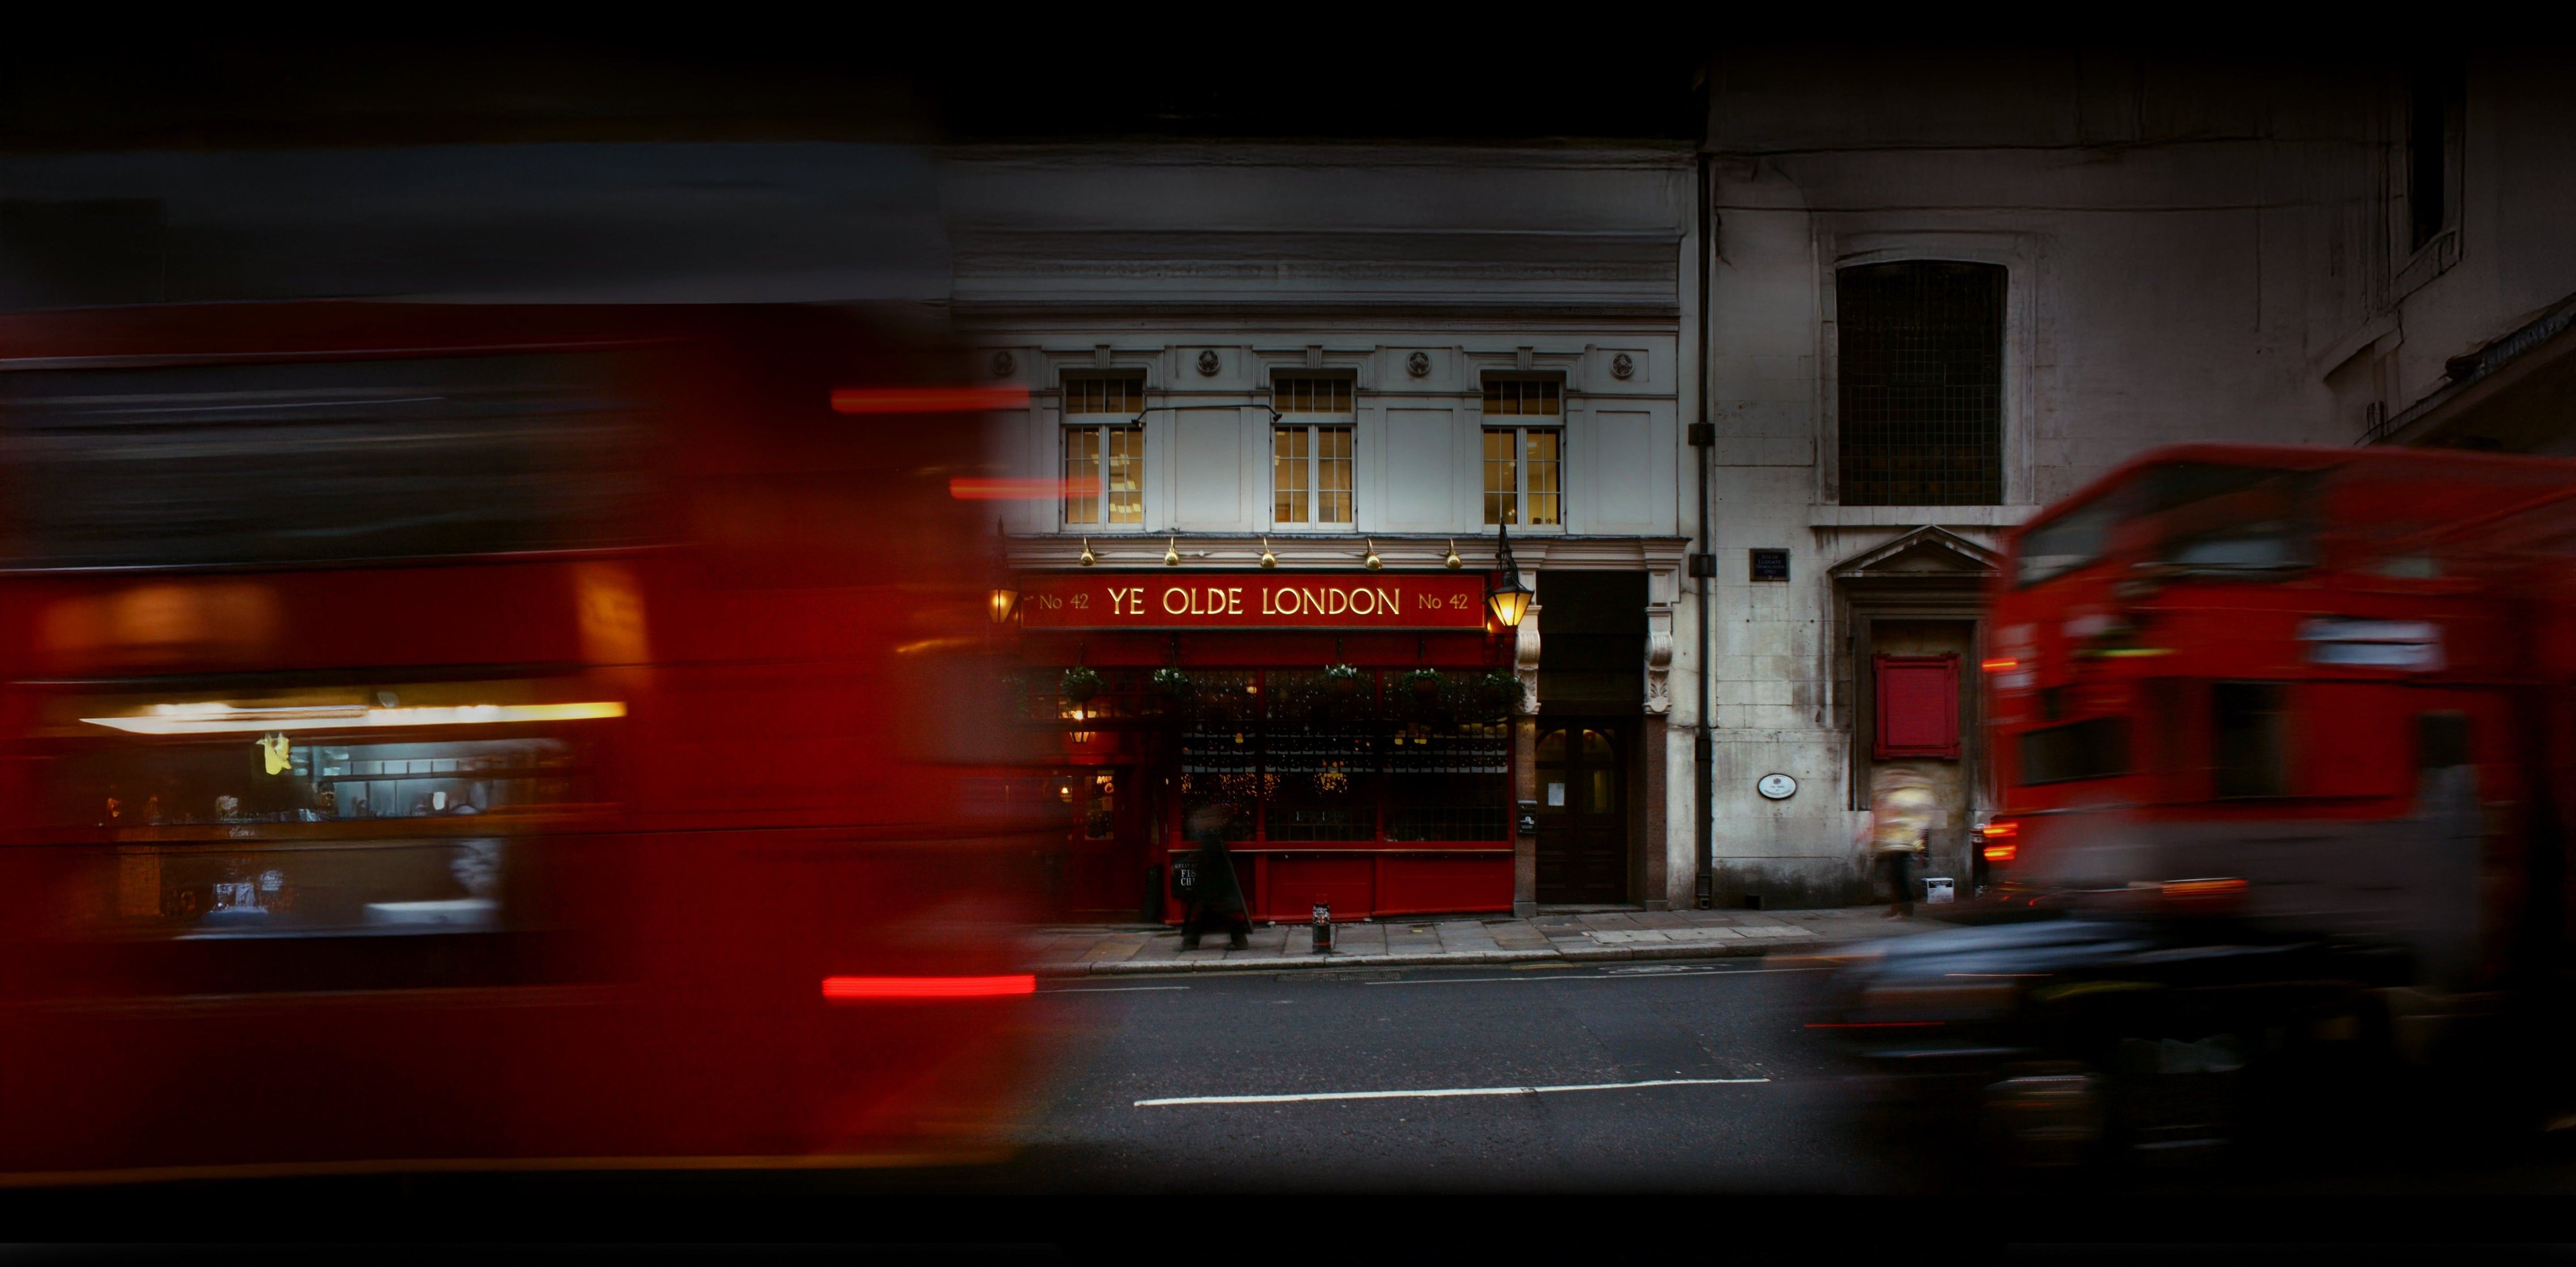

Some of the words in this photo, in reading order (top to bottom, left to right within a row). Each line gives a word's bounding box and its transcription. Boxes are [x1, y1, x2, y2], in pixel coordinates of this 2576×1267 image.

[1039, 593, 1063, 609] No
[1070, 593, 1089, 609] 42
[1107, 587, 1146, 615] YE
[1162, 587, 1244, 615] OLDE
[1262, 587, 1400, 615] LONDON
[1418, 593, 1442, 609] No
[1449, 593, 1468, 609] 42
[1181, 869, 1197, 878] FIS
